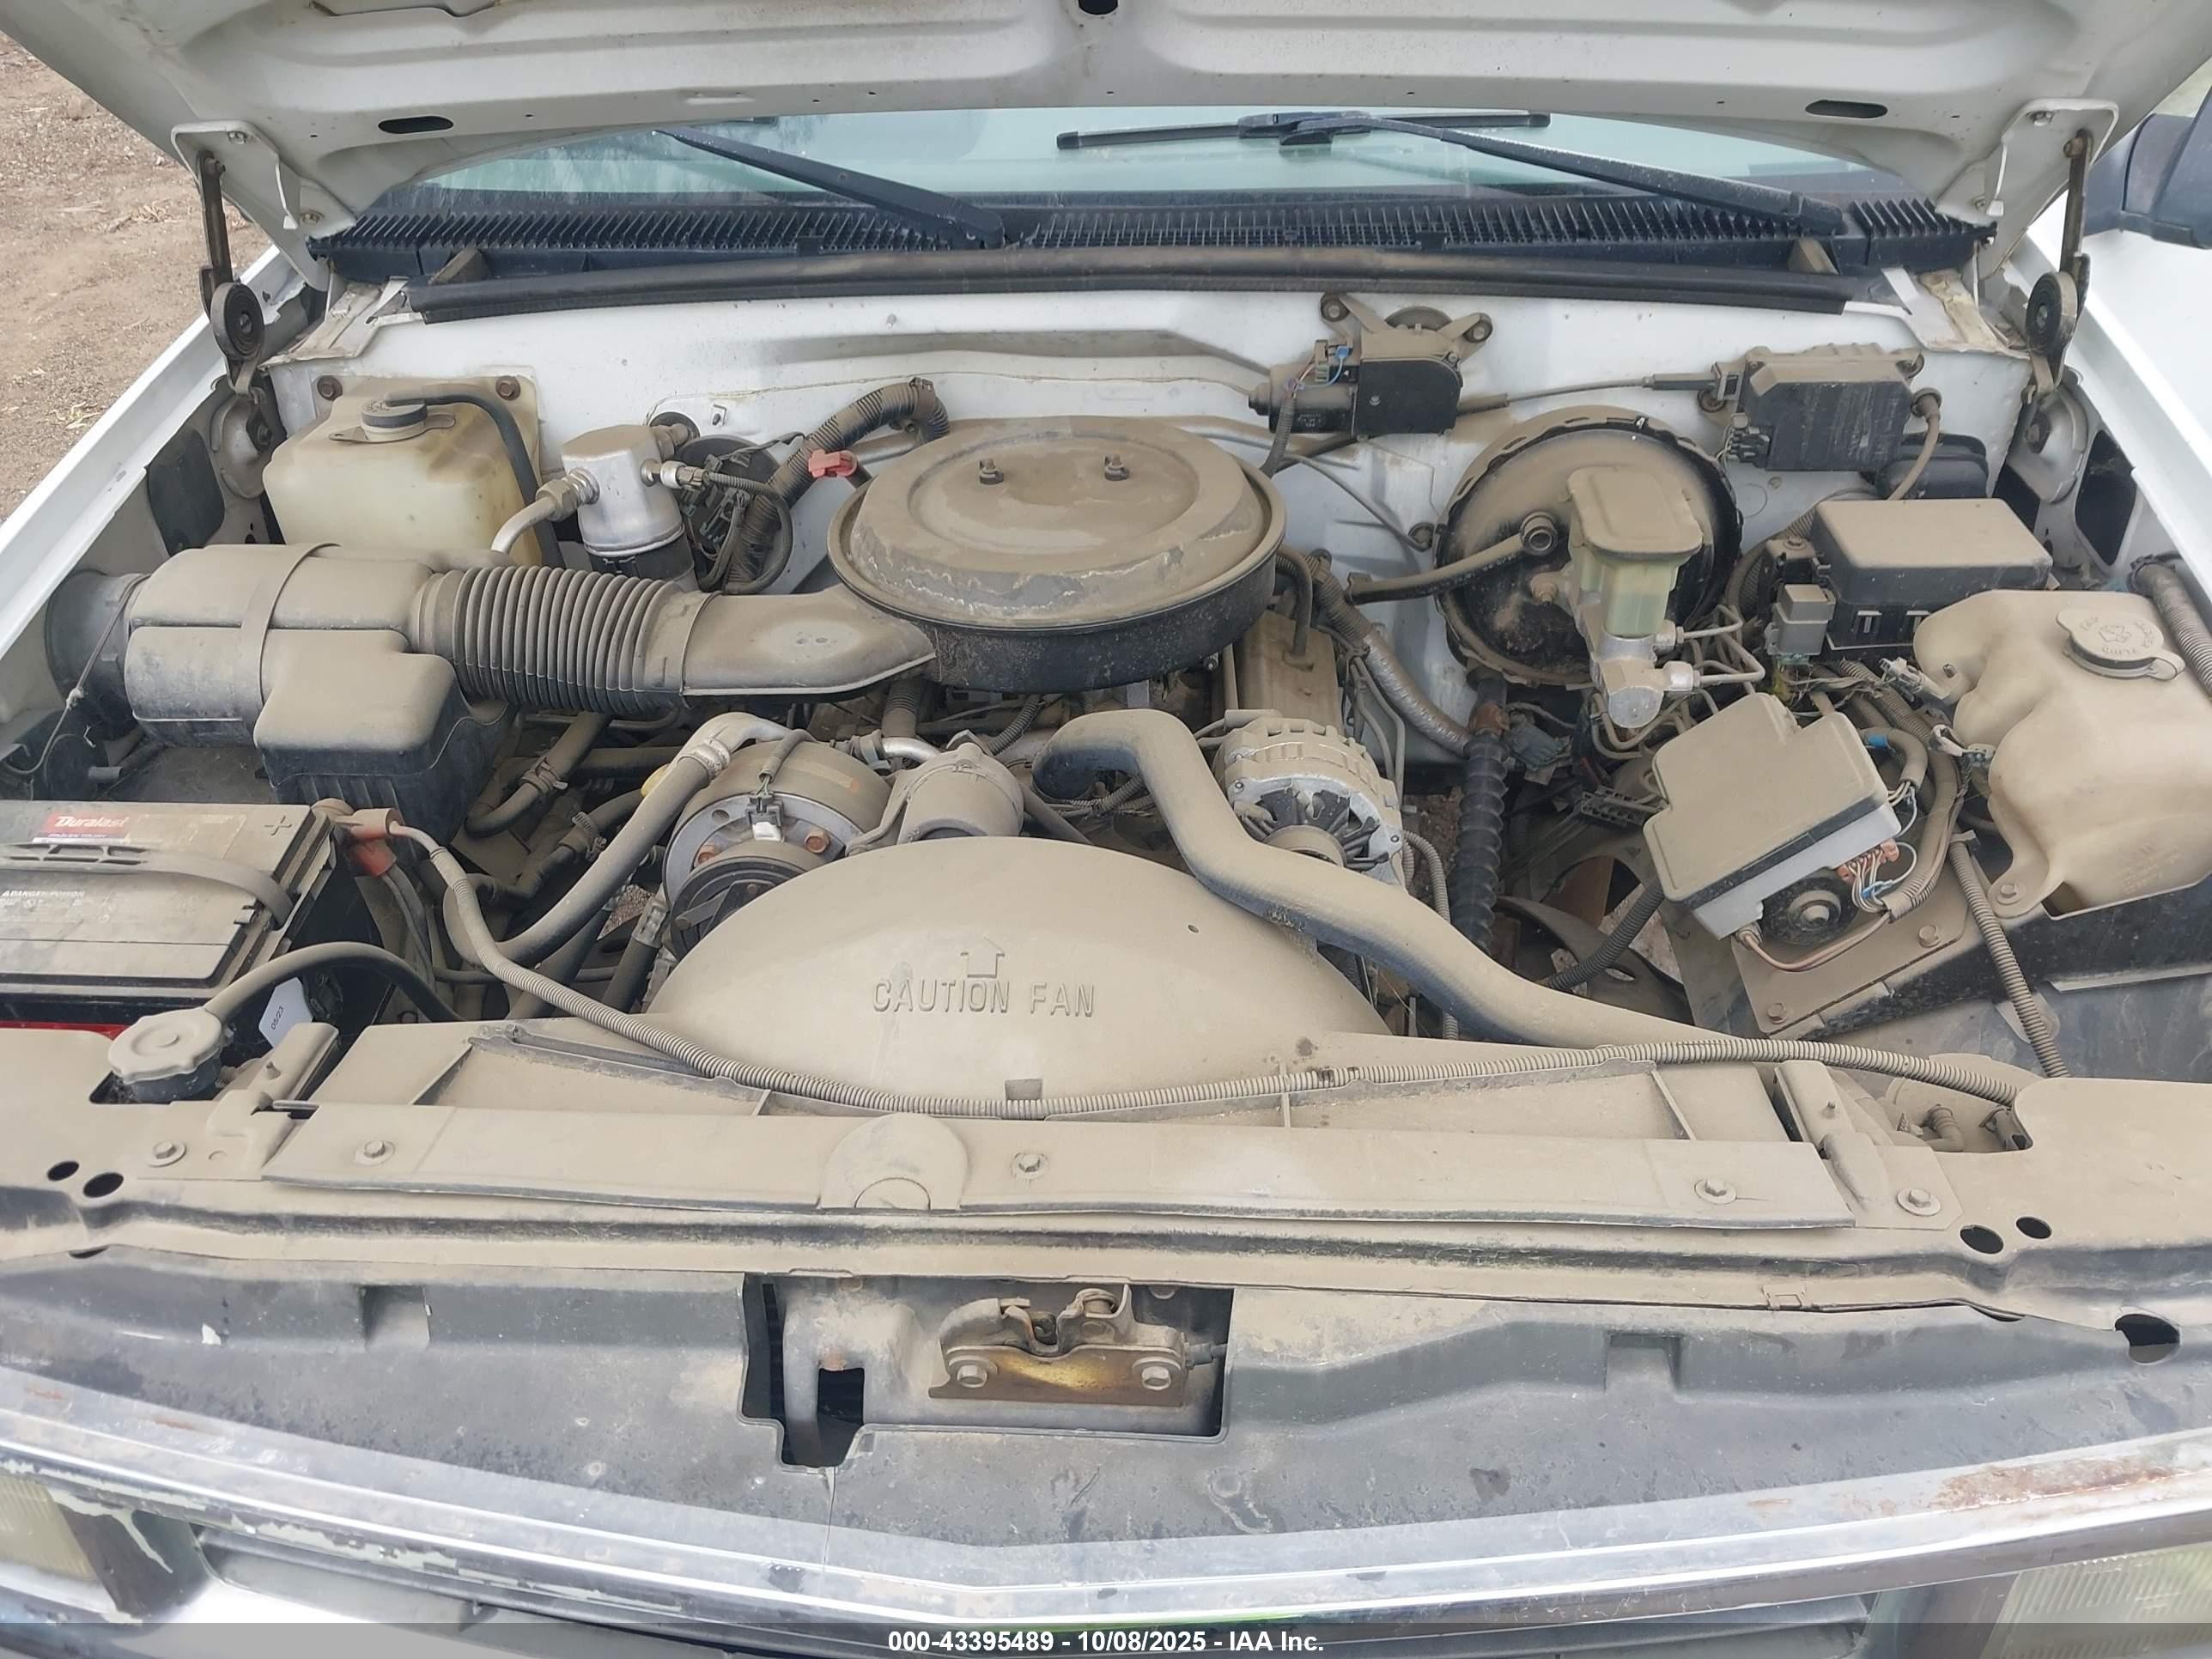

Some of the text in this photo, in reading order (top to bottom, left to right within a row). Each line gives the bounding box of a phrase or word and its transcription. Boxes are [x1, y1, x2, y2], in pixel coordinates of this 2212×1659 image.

[54, 816, 130, 828] Duralast
[873, 979, 1095, 1017] CAUTION FAN
[270, 1006, 284, 1030] 05/23
